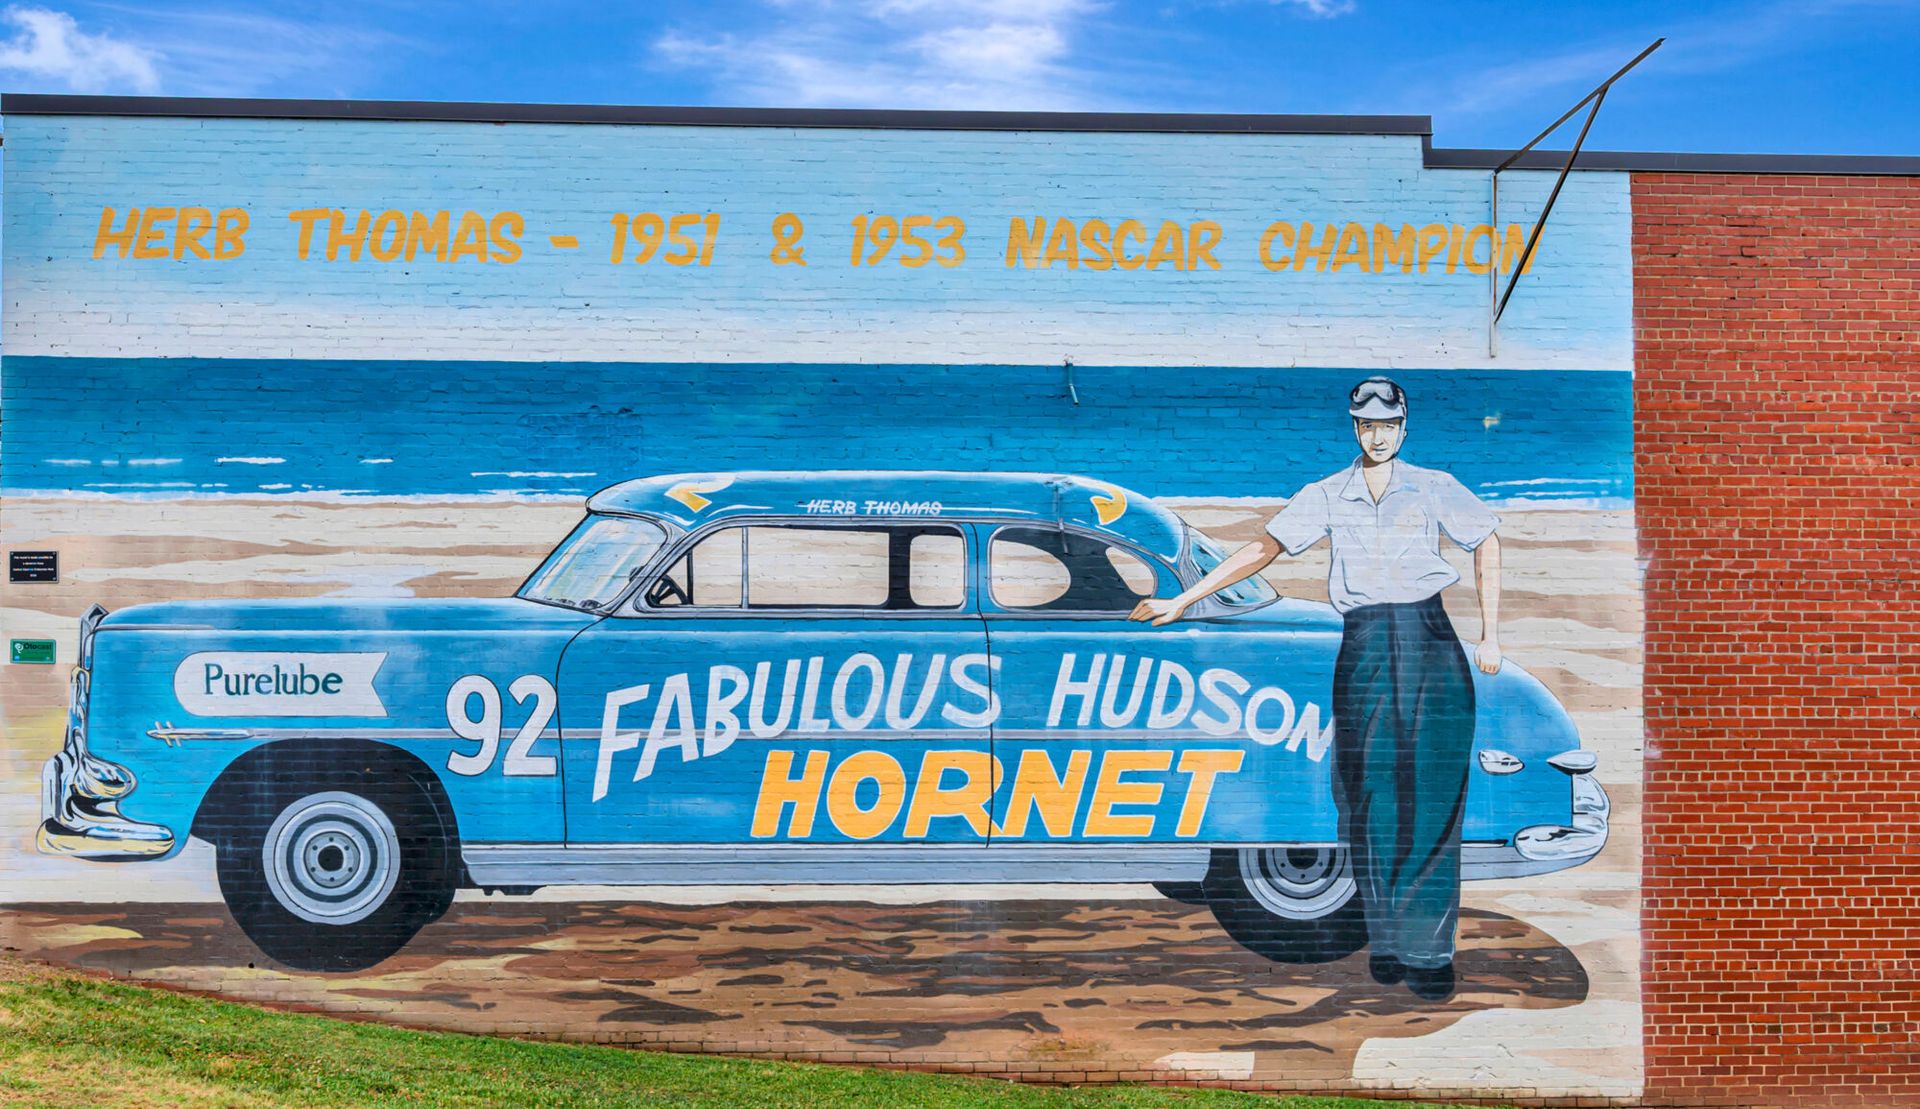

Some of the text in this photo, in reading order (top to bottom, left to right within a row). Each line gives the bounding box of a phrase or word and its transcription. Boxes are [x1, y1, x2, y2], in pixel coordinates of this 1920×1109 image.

[92, 207, 1546, 275] HERB THOMAS - 1951 & 1953 NASCAR CHAMPION
[806, 499, 943, 516] HERB THOMAS
[204, 663, 343, 696] Purelube
[446, 674, 558, 777] 92
[592, 652, 1336, 803] FABULOUS HUDSON
[750, 749, 1245, 840] HORNET
